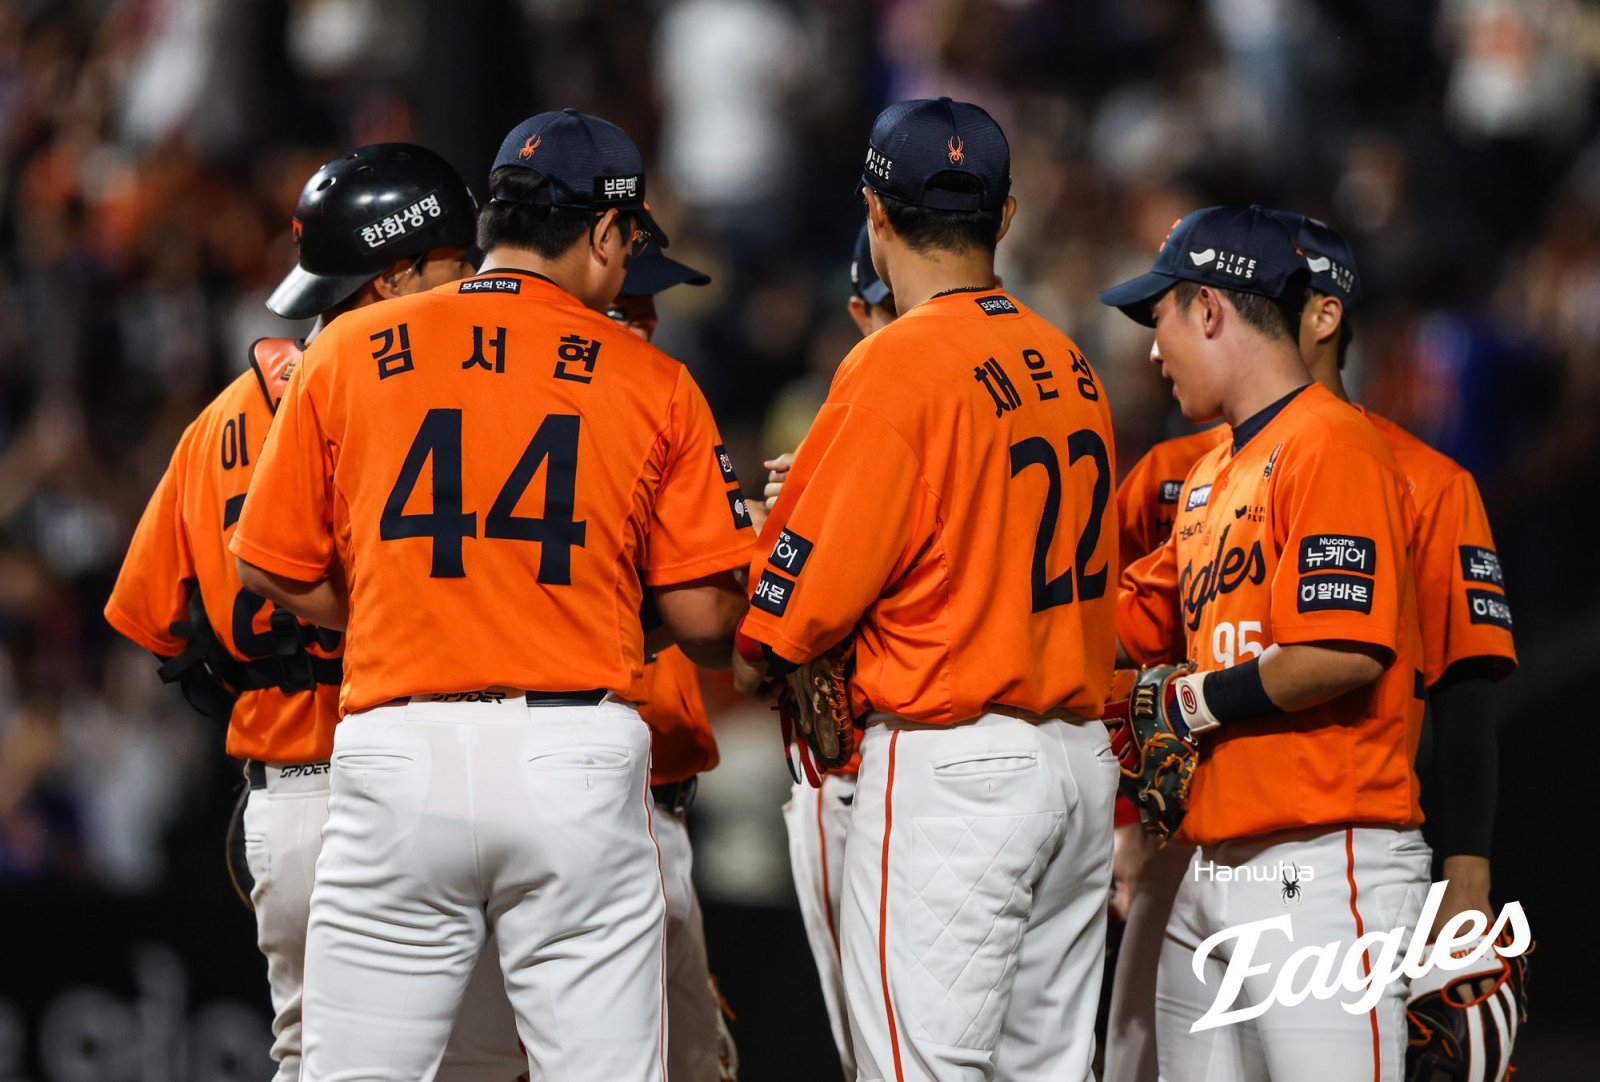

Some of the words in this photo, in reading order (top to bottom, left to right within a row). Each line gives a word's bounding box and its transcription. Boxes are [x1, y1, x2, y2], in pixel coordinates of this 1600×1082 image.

[869, 161, 890, 180] PLUS
[870, 151, 893, 170] LIFE
[604, 177, 637, 199] 부루펜
[361, 194, 441, 248] 한화생명
[1218, 251, 1257, 269] LIFE
[1216, 262, 1254, 279] PLUS
[460, 281, 493, 291] 모두의
[496, 280, 519, 291] 안과
[379, 408, 587, 586] 44
[1009, 428, 1111, 614] 22
[1319, 537, 1356, 547] Nucare
[1305, 546, 1366, 570] 뉴케어
[1317, 582, 1368, 603] 알바몬
[1212, 620, 1265, 670] 95
[280, 761, 331, 779] SPYDER
